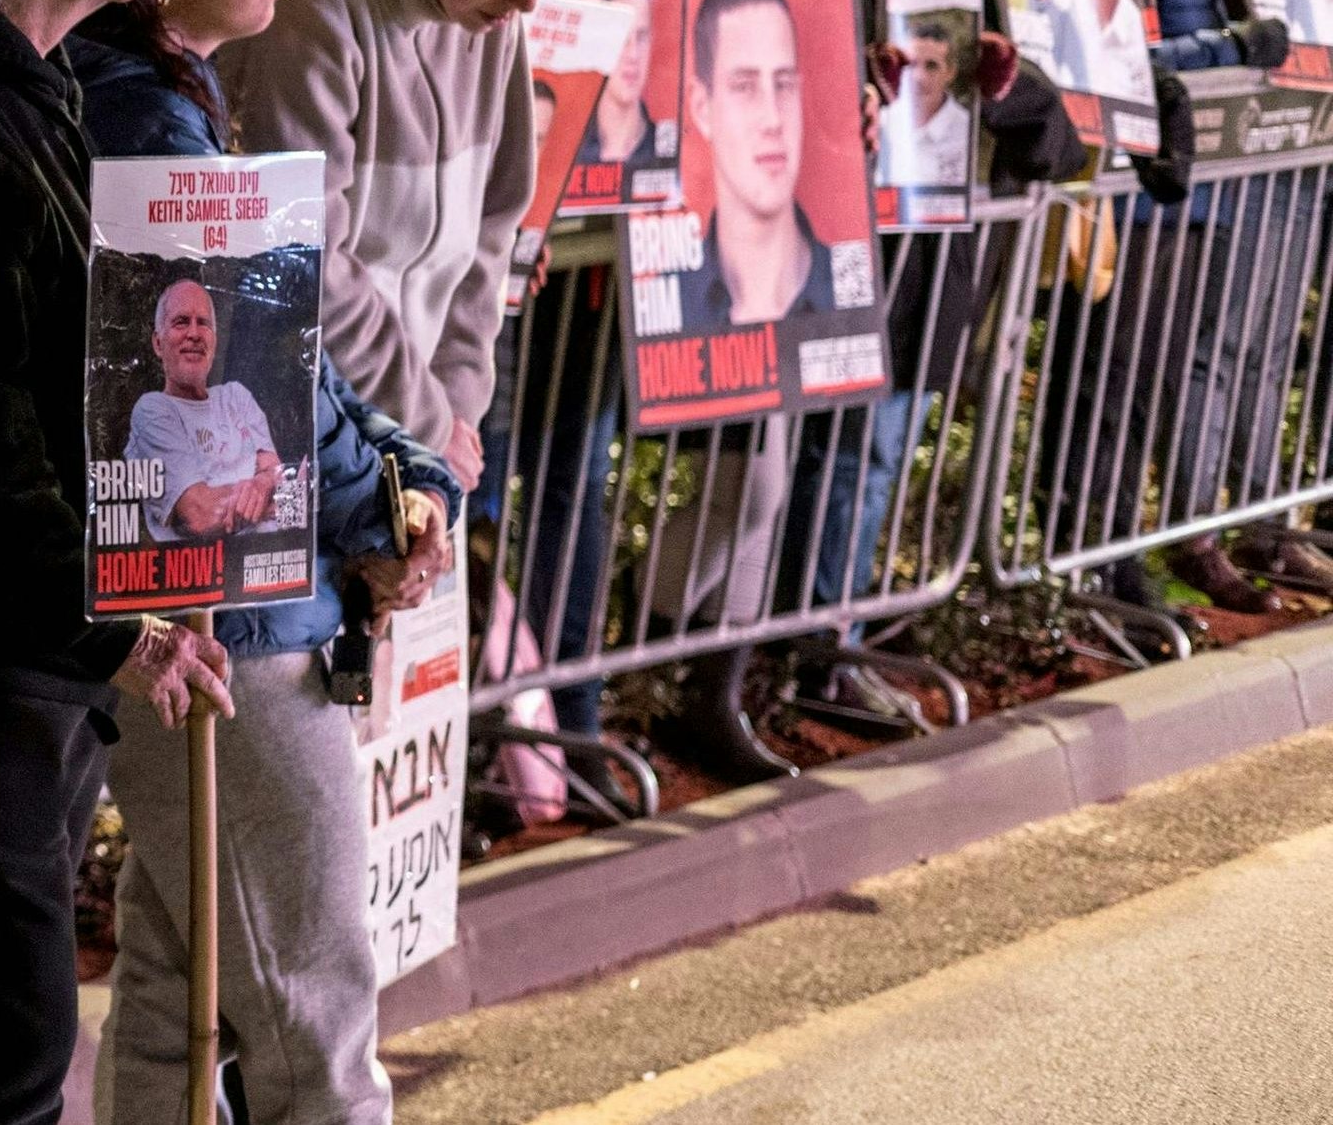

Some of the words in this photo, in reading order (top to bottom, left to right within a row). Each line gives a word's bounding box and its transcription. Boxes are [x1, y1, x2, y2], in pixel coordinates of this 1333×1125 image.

[169, 171, 196, 195] סיגל
[239, 171, 259, 195] קית
[149, 199, 183, 224] KEITH
[186, 197, 232, 222] SAMUEL
[204, 225, 228, 251] (64)
[628, 212, 704, 272] BRING
[634, 274, 683, 336] HIM
[637, 337, 709, 401] HOME
[709, 322, 779, 391] NOW!
[96, 458, 165, 501] BRING
[96, 503, 140, 546] HIM
[97, 550, 159, 593] HOME
[165, 540, 224, 588] NOW!
[243, 565, 279, 587] FAMILIES
[280, 562, 307, 582] FORUM
[372, 720, 453, 829] אבא
